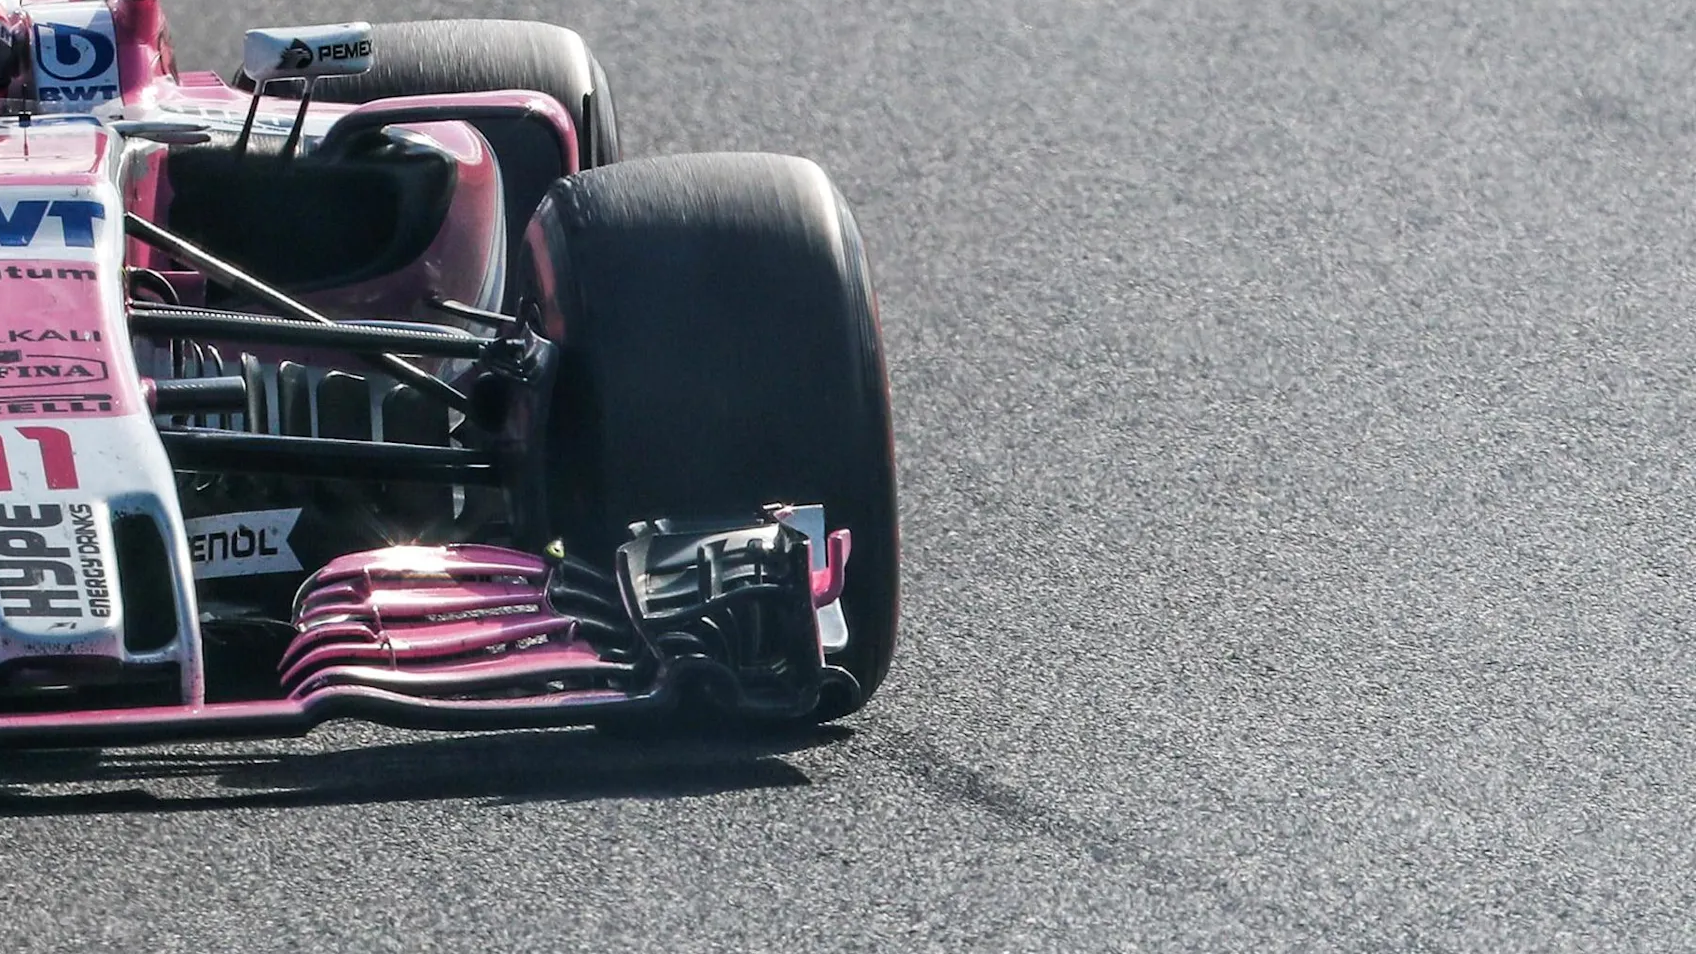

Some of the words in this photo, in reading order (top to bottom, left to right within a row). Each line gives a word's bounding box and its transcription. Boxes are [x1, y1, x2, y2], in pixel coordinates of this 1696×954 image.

[39, 85, 118, 101] BWT
[68, 503, 101, 554] DRINKS
[188, 528, 279, 562] ENOL
[80, 557, 111, 618] ENERGY
